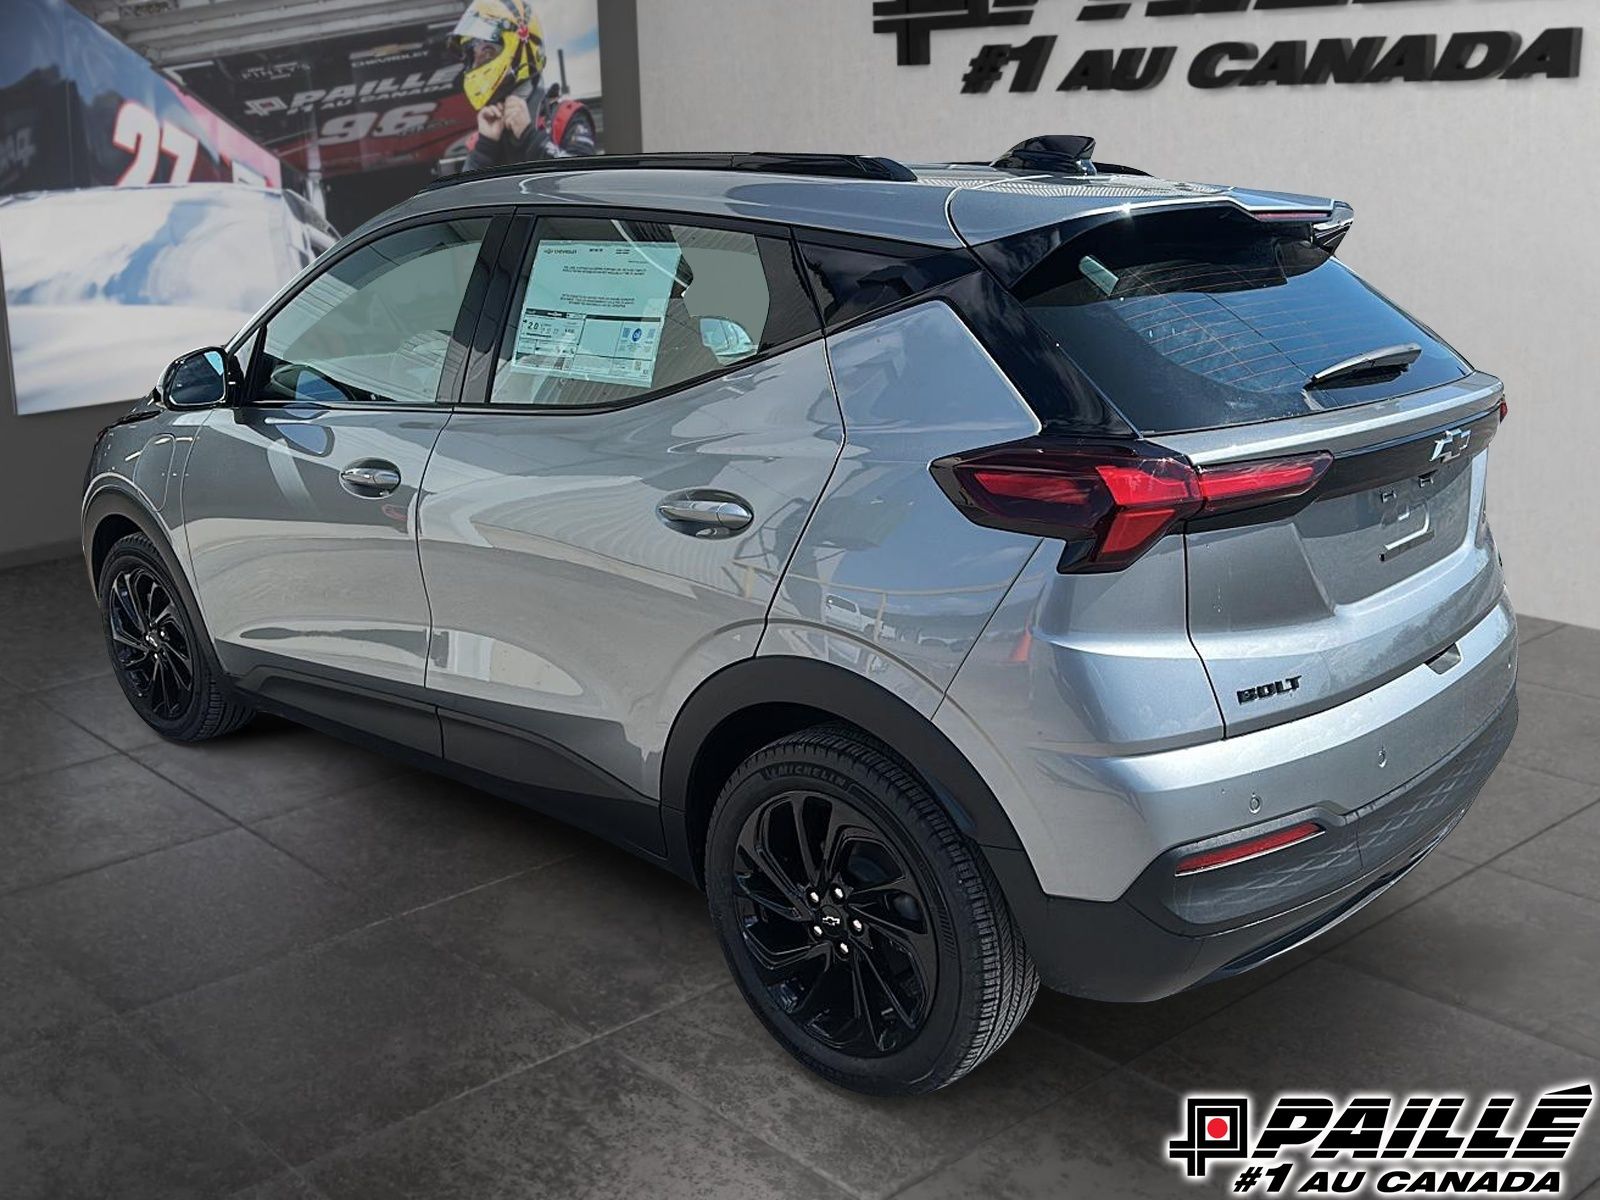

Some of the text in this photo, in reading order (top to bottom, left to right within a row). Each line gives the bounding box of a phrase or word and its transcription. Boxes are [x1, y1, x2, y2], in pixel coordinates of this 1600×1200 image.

[351, 50, 429, 68] CHEVROLET
[961, 27, 1583, 94] #1 AU CANADA
[361, 83, 453, 103] CANADA
[317, 102, 437, 146] 96
[113, 100, 199, 187] 27
[1236, 674, 1302, 705] BOLT
[776, 764, 847, 787] MICHELIN
